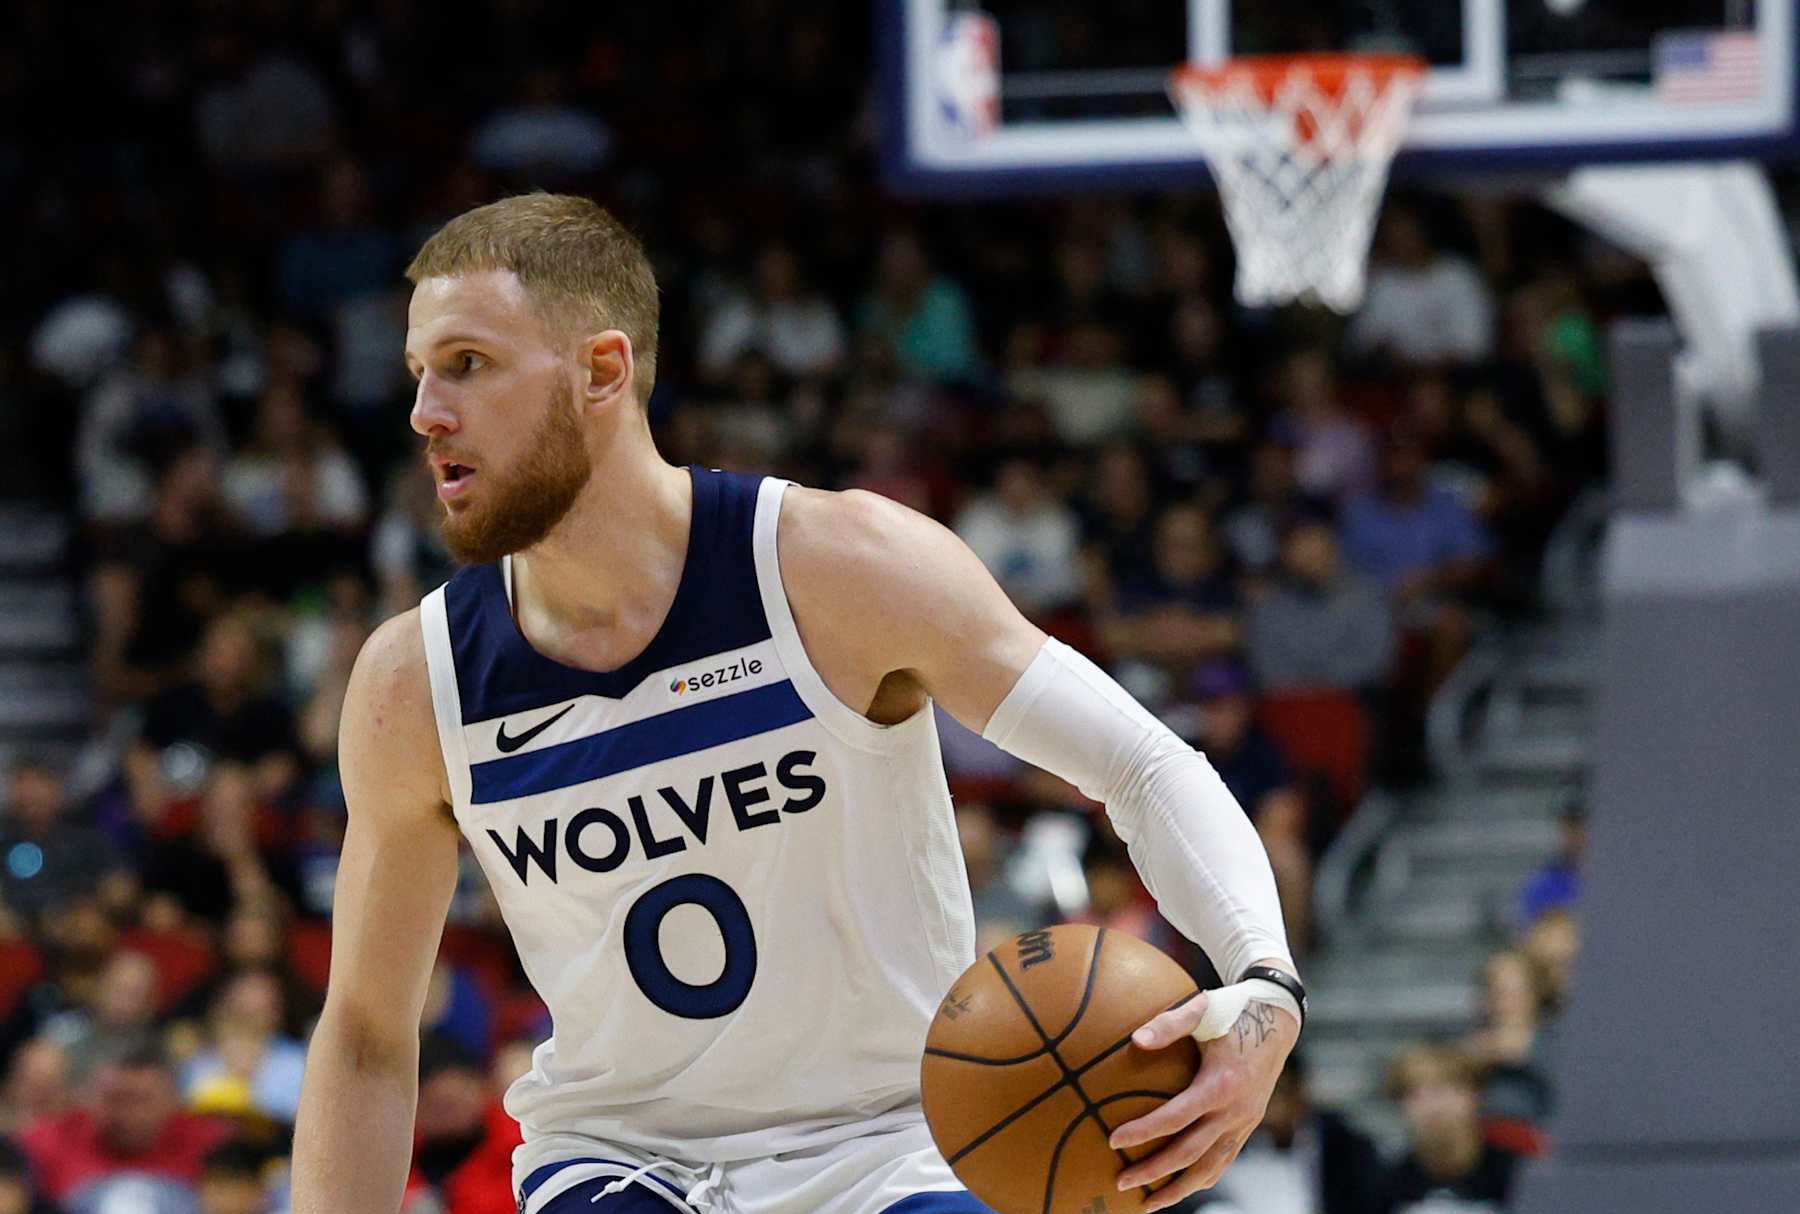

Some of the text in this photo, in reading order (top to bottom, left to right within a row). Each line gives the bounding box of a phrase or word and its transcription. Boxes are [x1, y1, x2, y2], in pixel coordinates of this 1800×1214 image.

[688, 657, 763, 691] sezzle
[486, 750, 827, 887] WOLVES
[622, 872, 758, 1020] 0
